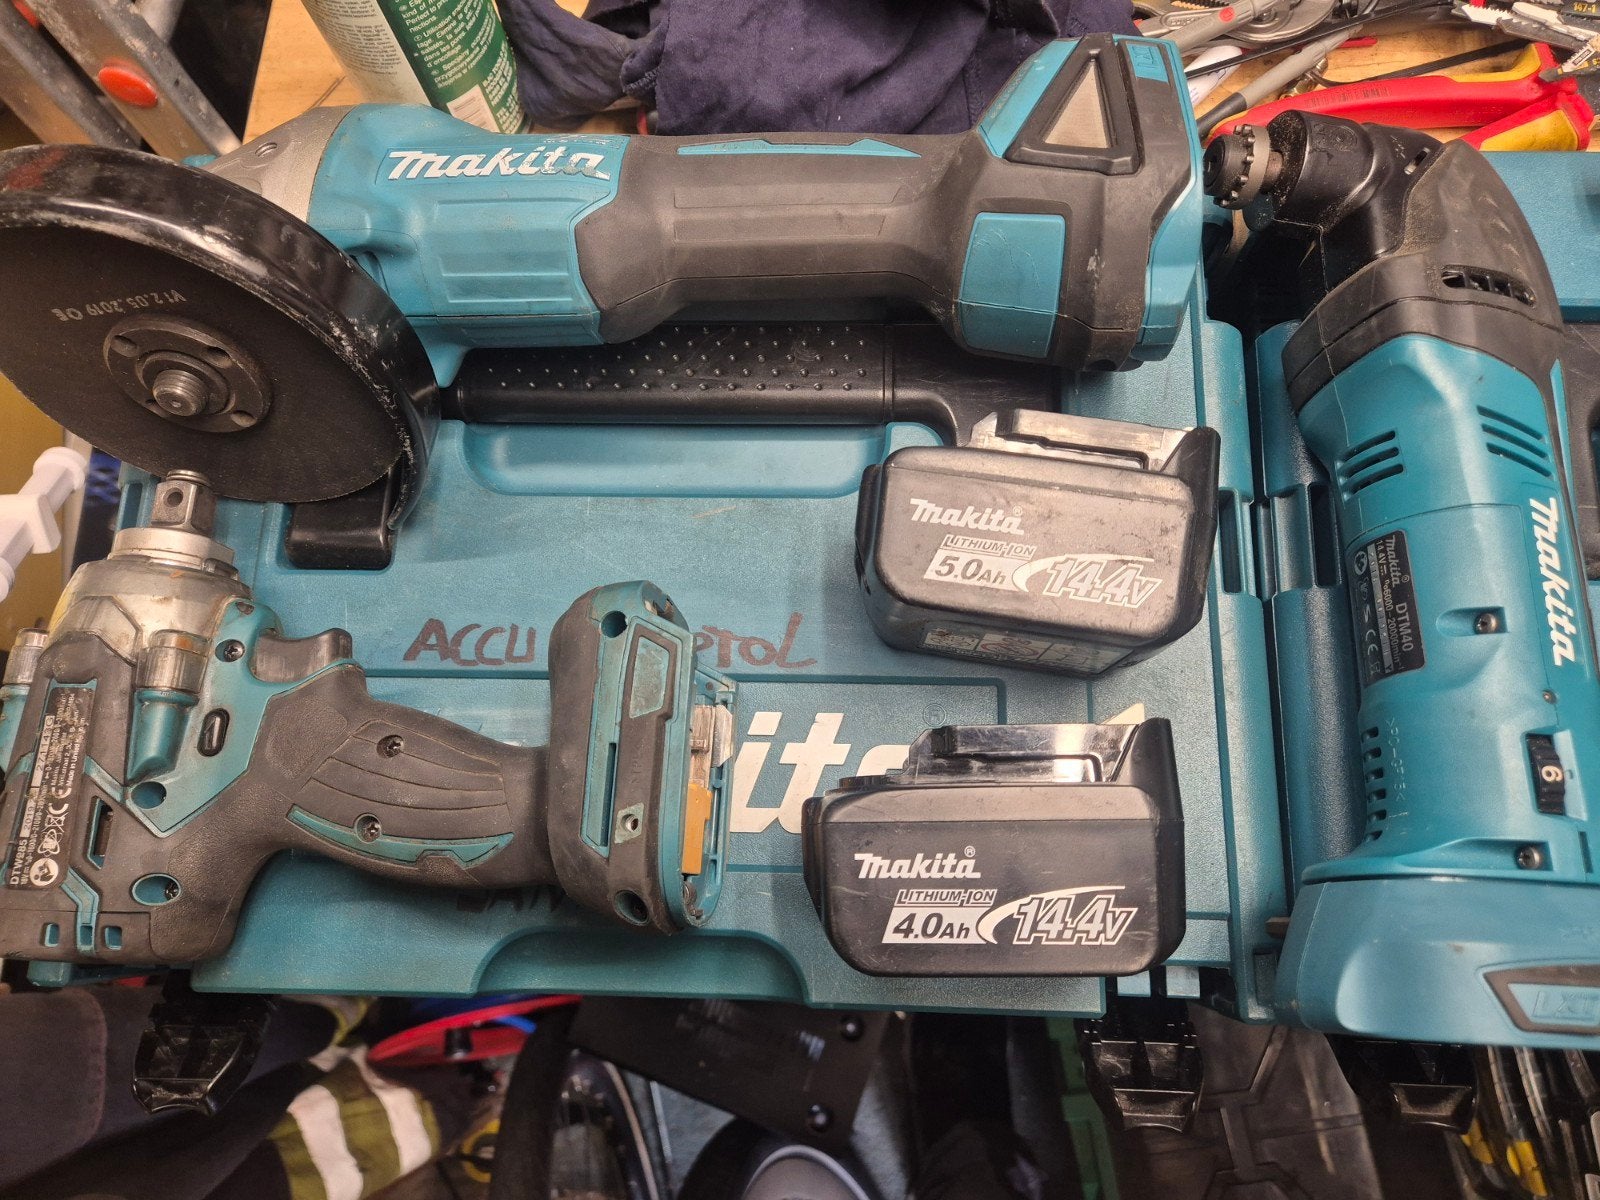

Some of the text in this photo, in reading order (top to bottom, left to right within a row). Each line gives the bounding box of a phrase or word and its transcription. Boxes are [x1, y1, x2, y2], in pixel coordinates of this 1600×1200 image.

[935, 556, 1006, 586] 5.0Ah
[403, 618, 536, 667] ACCU
[1396, 602, 1414, 652] DTM40
[1540, 765, 1562, 782] 6
[10, 839, 28, 884] DTW285
[893, 913, 970, 939] 4.0Ah
